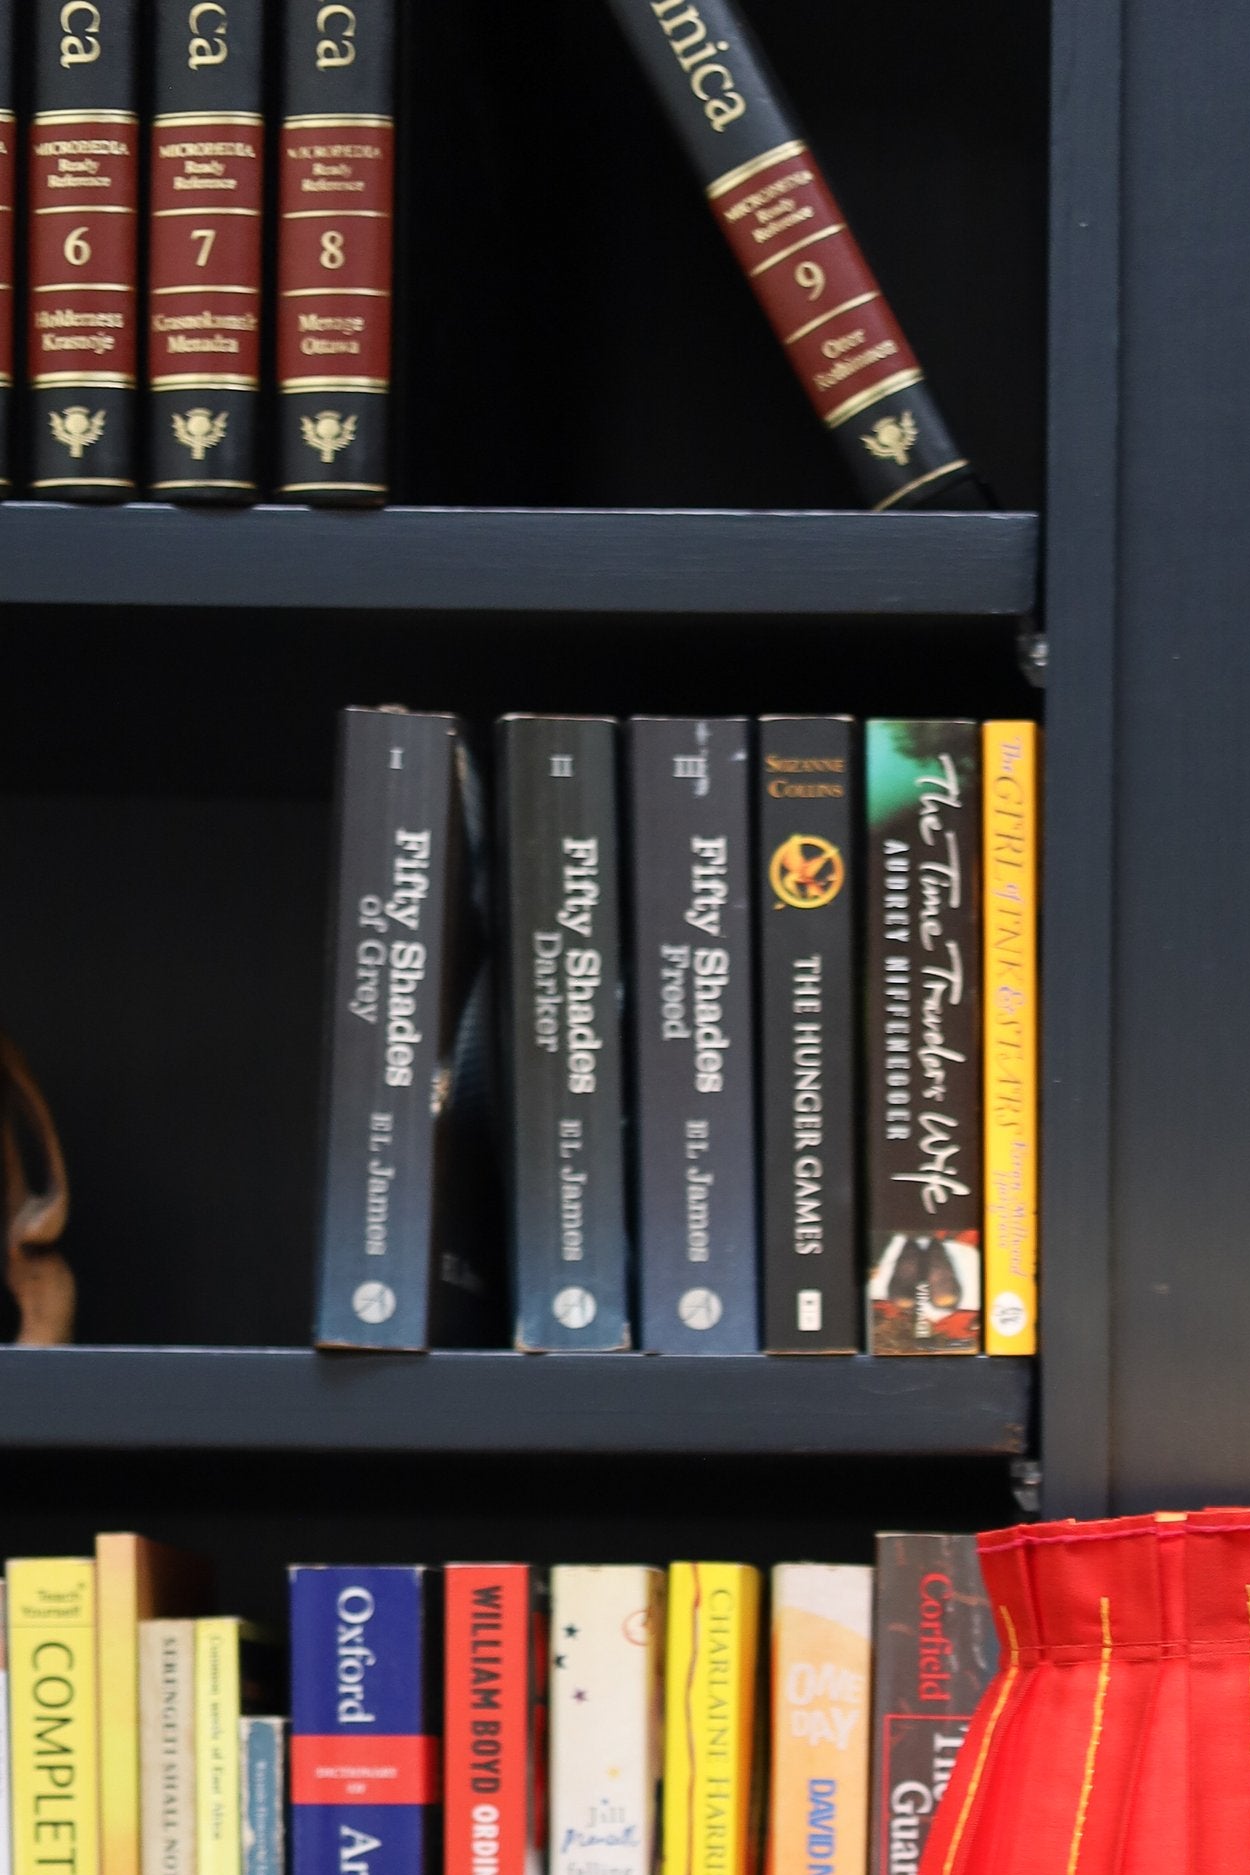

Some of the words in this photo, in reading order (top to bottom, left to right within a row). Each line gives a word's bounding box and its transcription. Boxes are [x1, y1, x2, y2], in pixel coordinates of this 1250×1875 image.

[63, 226, 92, 267] 6
[190, 228, 217, 268] 7
[319, 230, 346, 270] 8
[794, 261, 826, 301] 9
[914, 753, 960, 847] The
[358, 896, 383, 932] of
[386, 829, 431, 931] Fifty
[558, 837, 599, 936] Fifty
[685, 836, 728, 936] Fifty
[883, 839, 912, 943] AUDREY
[914, 831, 960, 952] Time
[349, 940, 385, 1024] Grey
[385, 941, 427, 1087] Shades
[532, 931, 562, 1054] Darker
[564, 948, 602, 1095] Shades
[660, 944, 692, 1041] Freed
[692, 947, 731, 1093] Shades
[792, 954, 823, 1014] THE
[792, 1022, 824, 1150] HUNGER
[364, 1160, 395, 1256] James
[792, 1156, 824, 1256] GAMES
[890, 1110, 971, 1217] Wife
[558, 1166, 588, 1262] James
[685, 1167, 715, 1263] James
[336, 1586, 376, 1724] Oxford
[469, 1585, 503, 1710] WILLIAM
[703, 1589, 733, 1763] CHARLAINE
[916, 1573, 953, 1702] Corfield
[161, 1763, 179, 1834] SHALL
[469, 1719, 502, 1794] BOYD
[806, 1778, 836, 1859] DAVID
